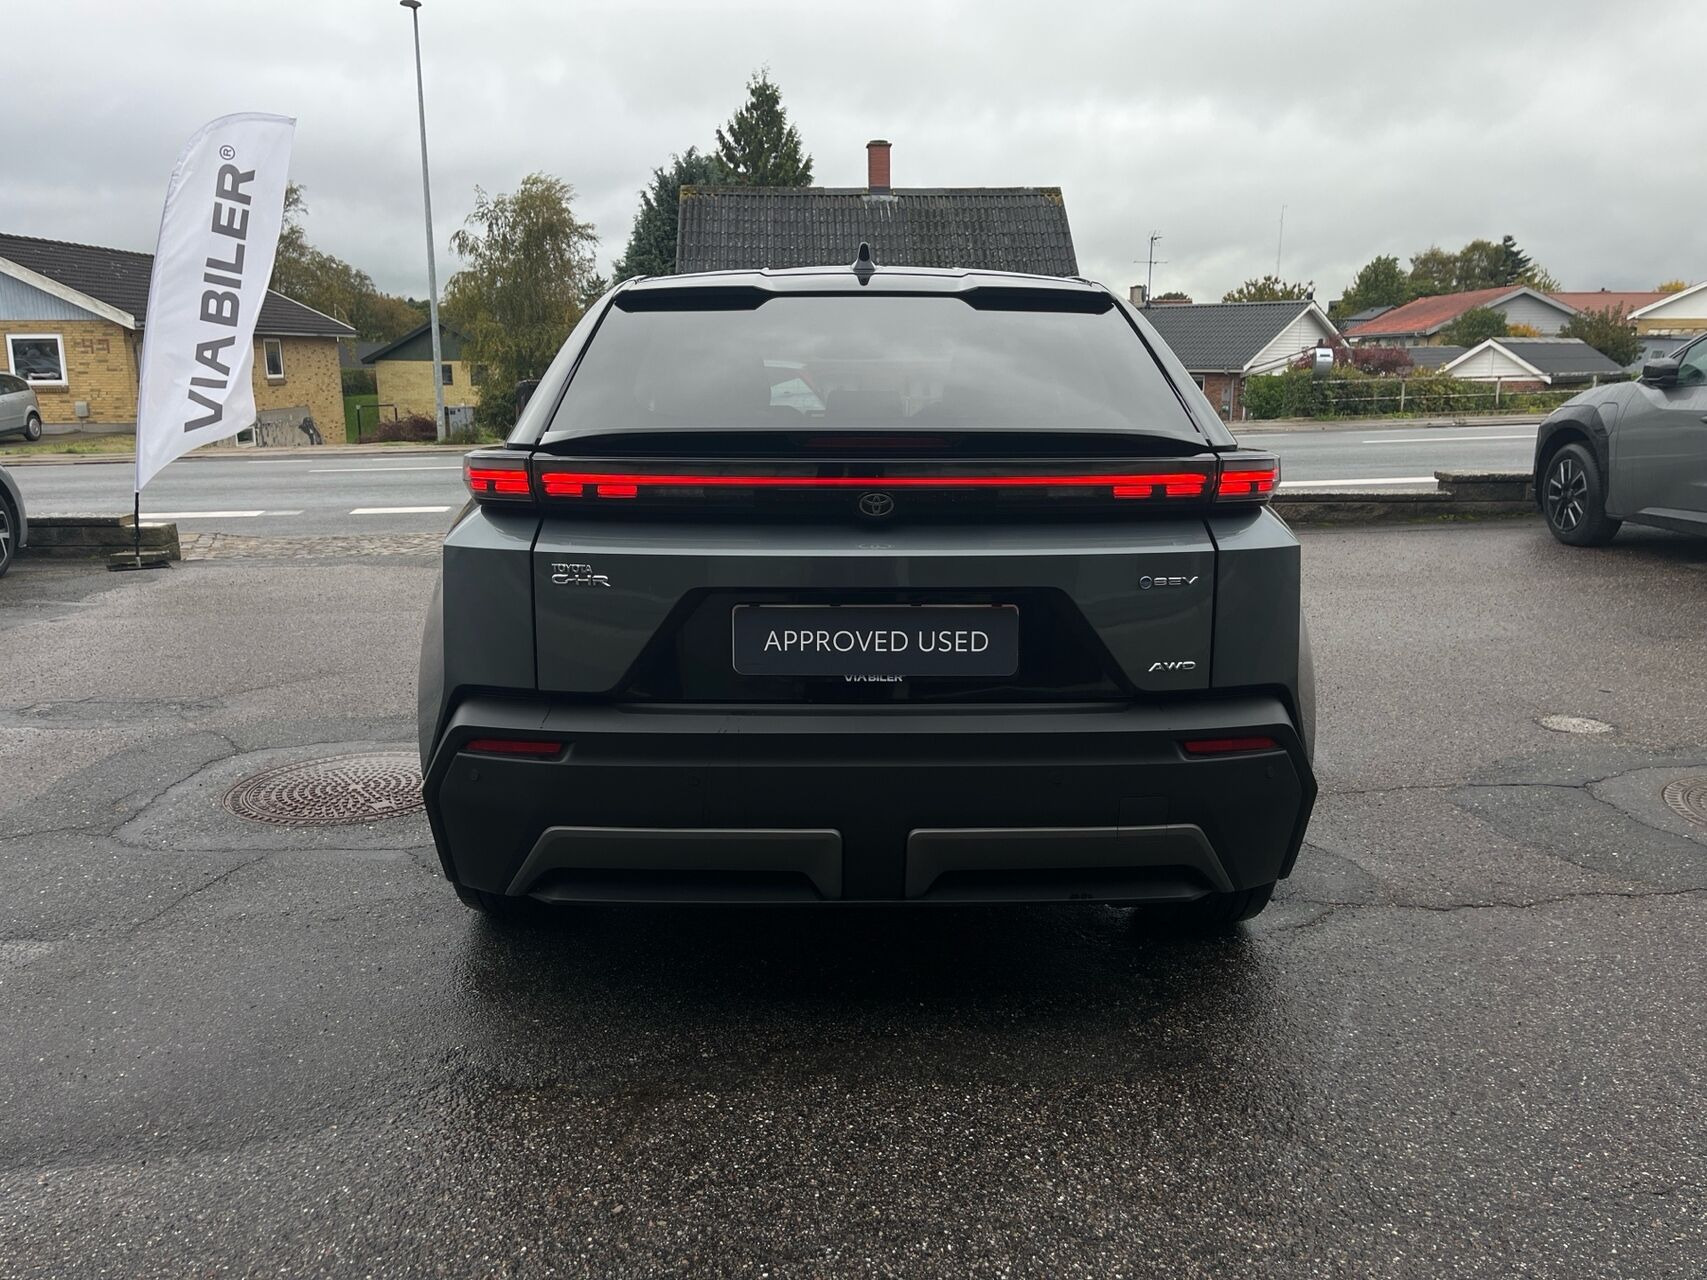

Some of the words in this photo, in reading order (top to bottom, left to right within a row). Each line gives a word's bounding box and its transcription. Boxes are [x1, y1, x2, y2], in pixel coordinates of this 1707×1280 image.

[184, 336, 236, 433] VIA
[552, 563, 592, 573] TOYOTA
[551, 574, 611, 587] C-HR
[764, 630, 909, 652] APPROVED
[918, 631, 989, 652] USED
[1148, 661, 1197, 673] AWD
